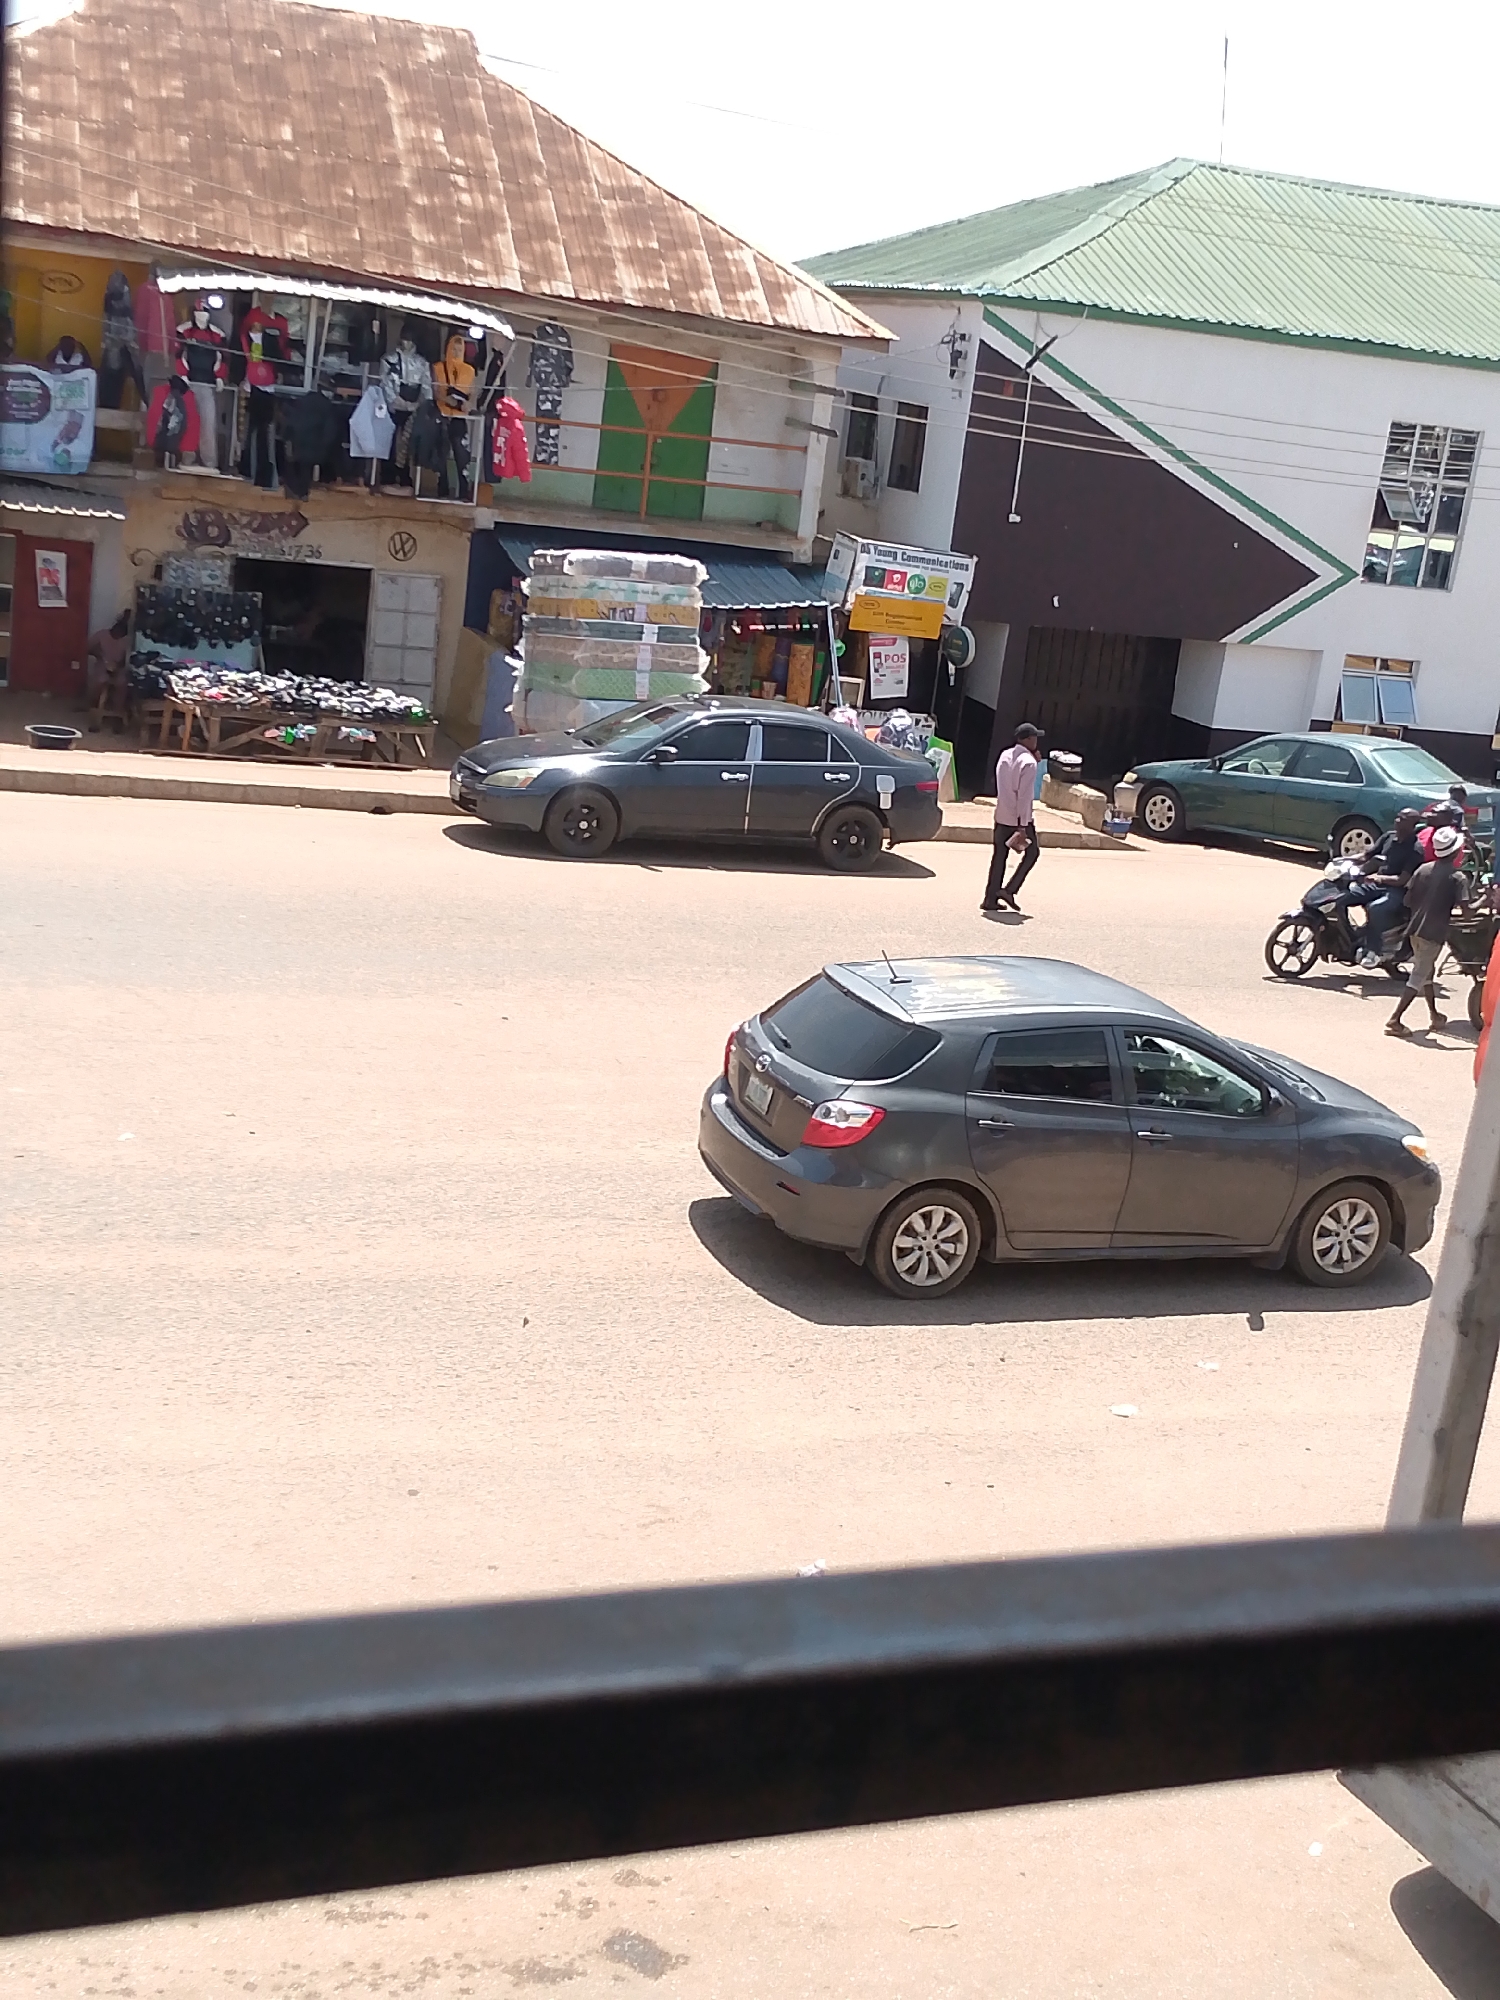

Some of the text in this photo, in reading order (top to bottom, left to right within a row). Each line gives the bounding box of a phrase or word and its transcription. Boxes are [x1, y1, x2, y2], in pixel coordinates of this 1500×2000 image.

[873, 545, 898, 561] Young
[901, 551, 970, 572] Communications
[909, 577, 924, 590] glo
[884, 653, 907, 664] POS
